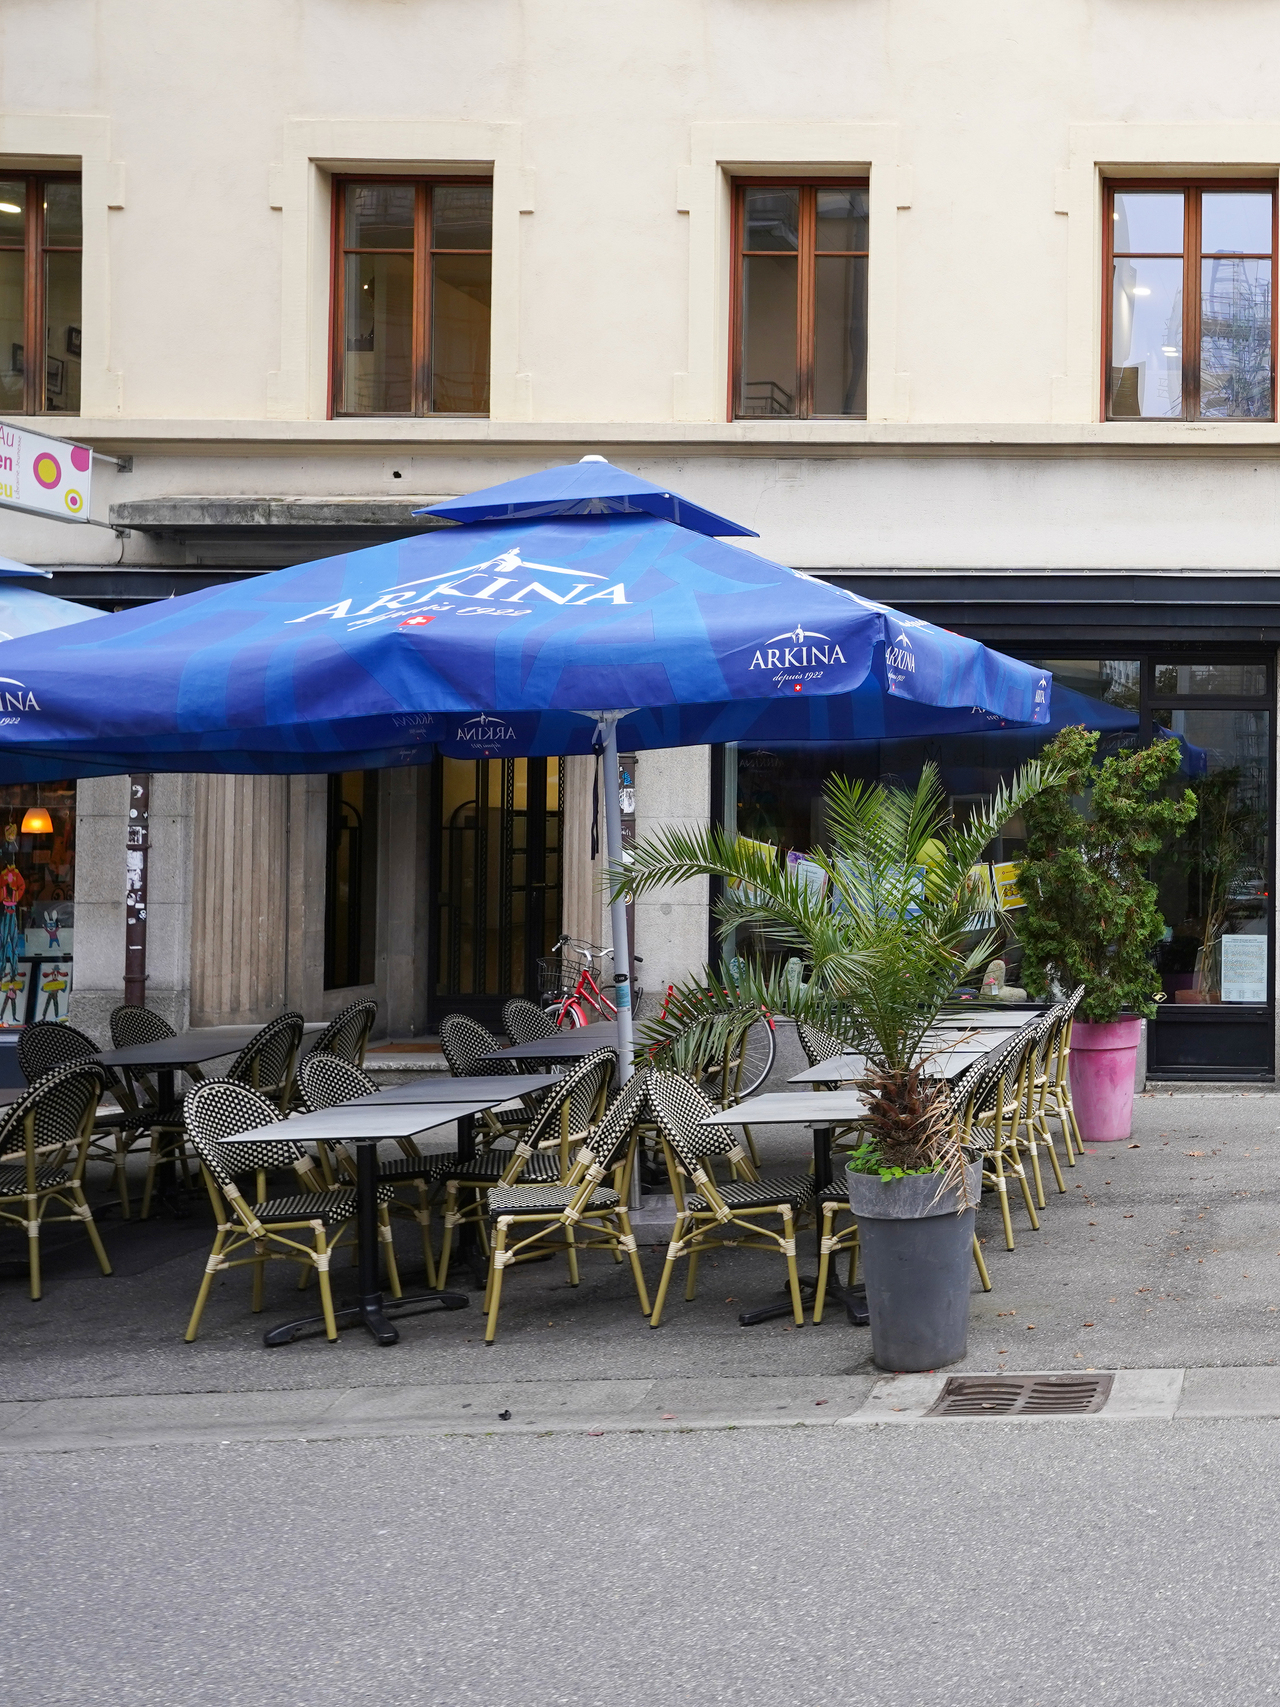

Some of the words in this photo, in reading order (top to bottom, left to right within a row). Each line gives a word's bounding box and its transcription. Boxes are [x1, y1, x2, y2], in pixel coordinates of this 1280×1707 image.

[284, 574, 634, 624] ARKINA
[456, 606, 533, 617] 1922
[748, 644, 848, 670] ARKINA
[885, 645, 916, 673] ARKINA
[772, 672, 803, 688] depuis
[804, 671, 824, 680] 1922
